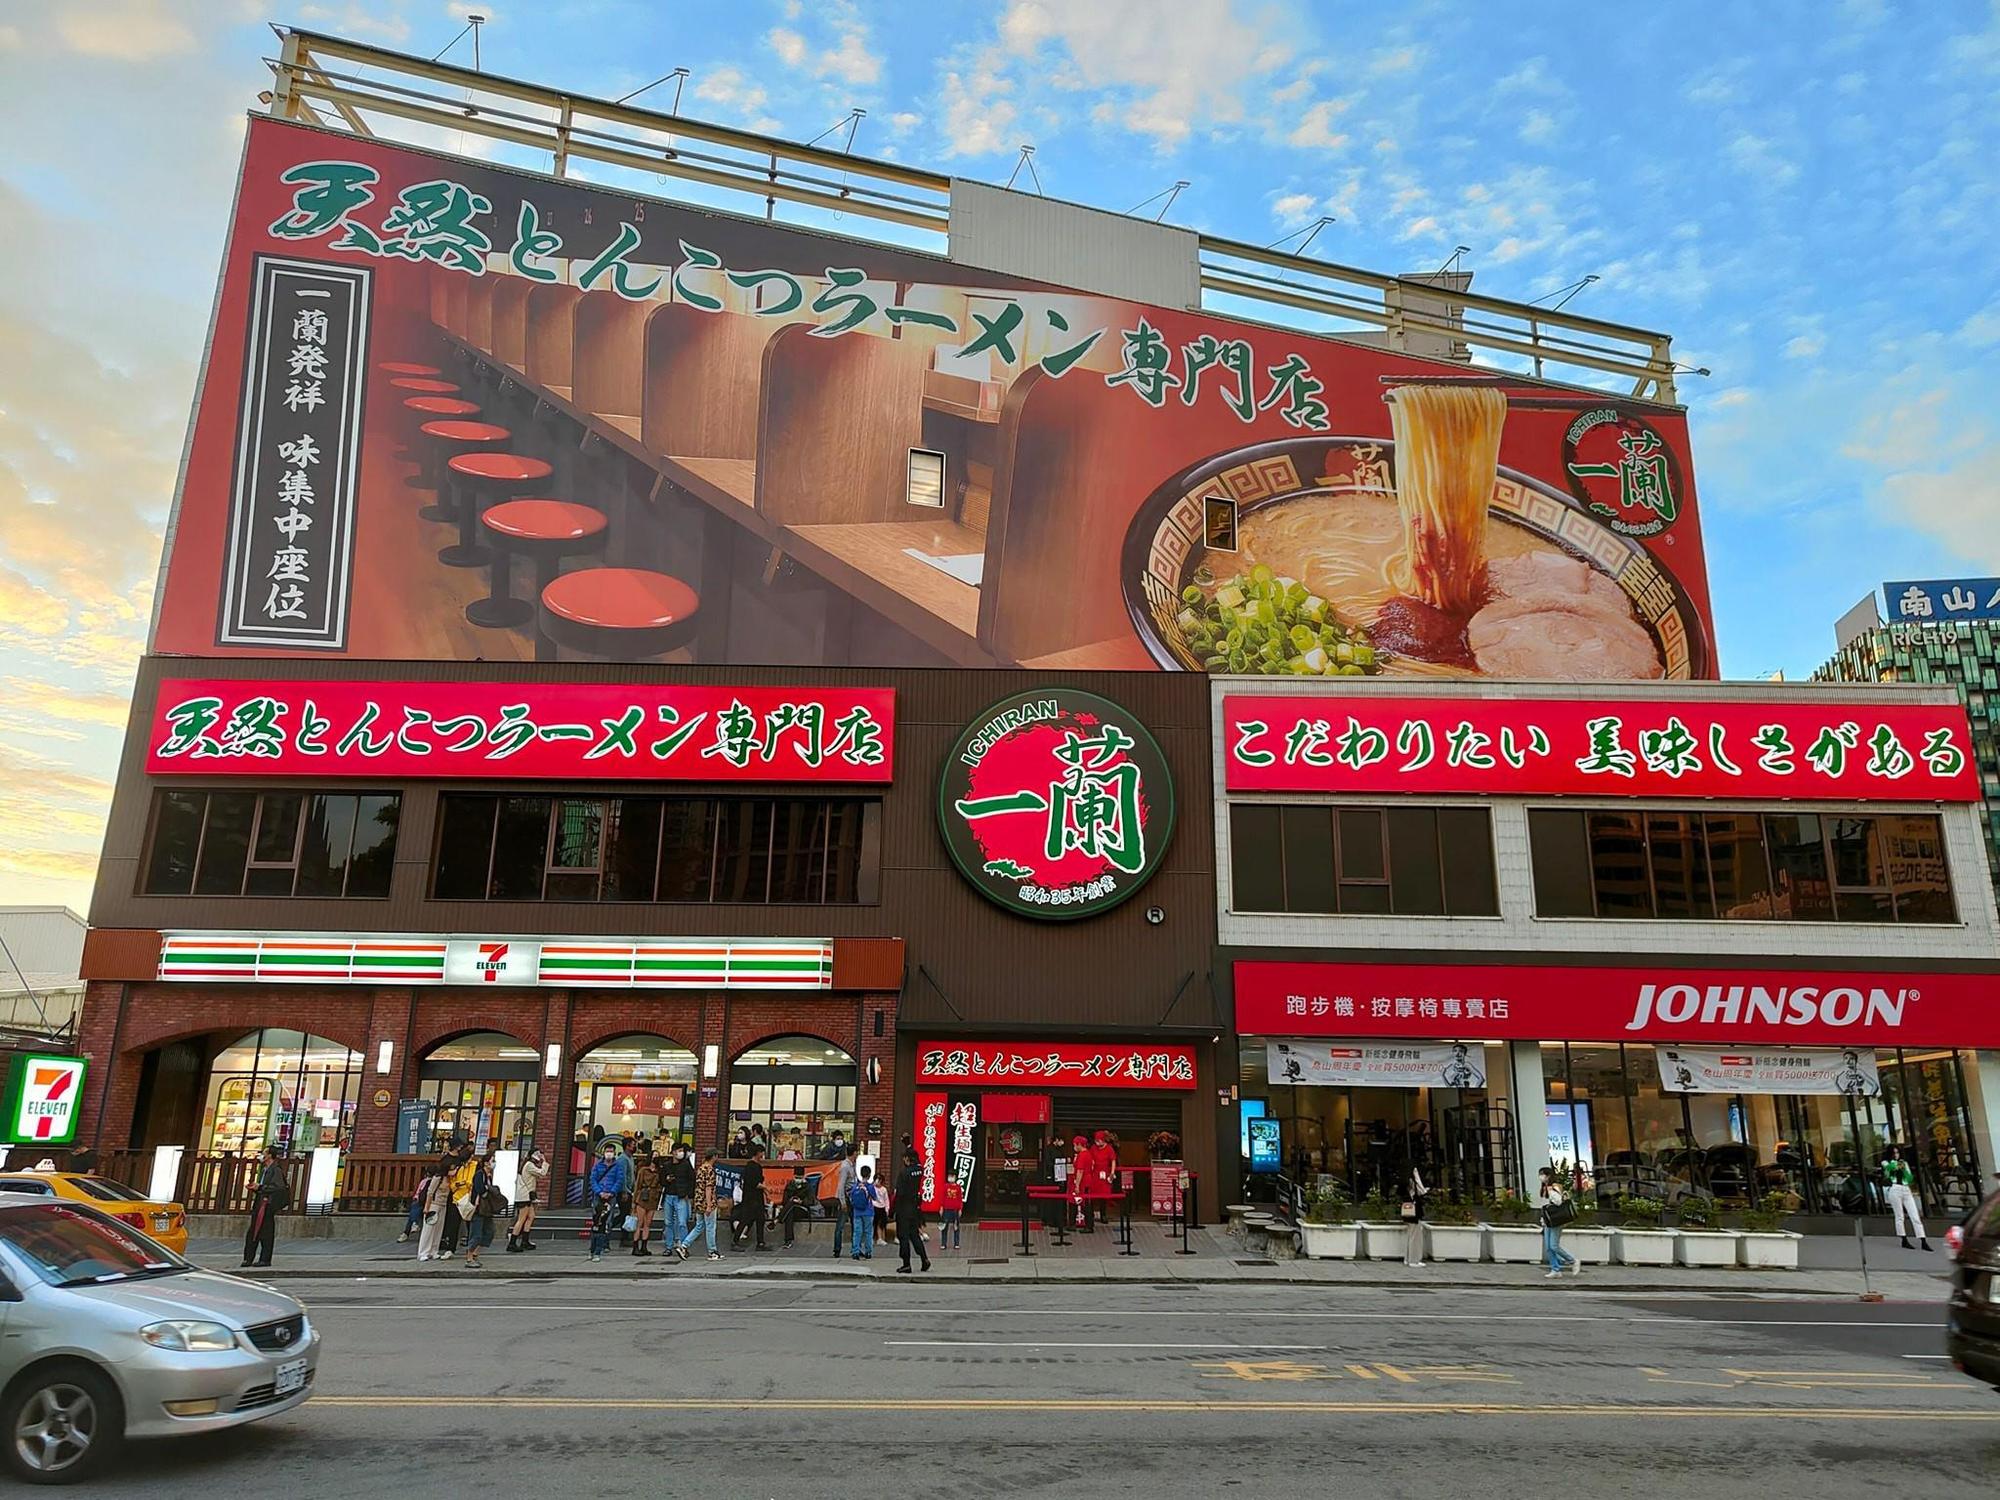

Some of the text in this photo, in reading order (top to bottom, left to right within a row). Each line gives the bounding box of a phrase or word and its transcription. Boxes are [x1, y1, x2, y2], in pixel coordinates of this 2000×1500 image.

[268, 161, 1331, 431] 天然とんこつラーメン専門店
[262, 289, 331, 621] 一蘭発祥 味集中座位
[1567, 409, 1618, 446] ICHIRAN
[1567, 430, 1676, 521] 一蘭
[157, 696, 885, 768] 天然とんこつラーメン専門店
[961, 699, 1059, 768] ICHIRAN
[1233, 716, 1965, 780] こだわりたい 美味しさがある
[954, 724, 1147, 874] 一蘭
[922, 1050, 1193, 1081] 天然とんこつラーメン専門店
